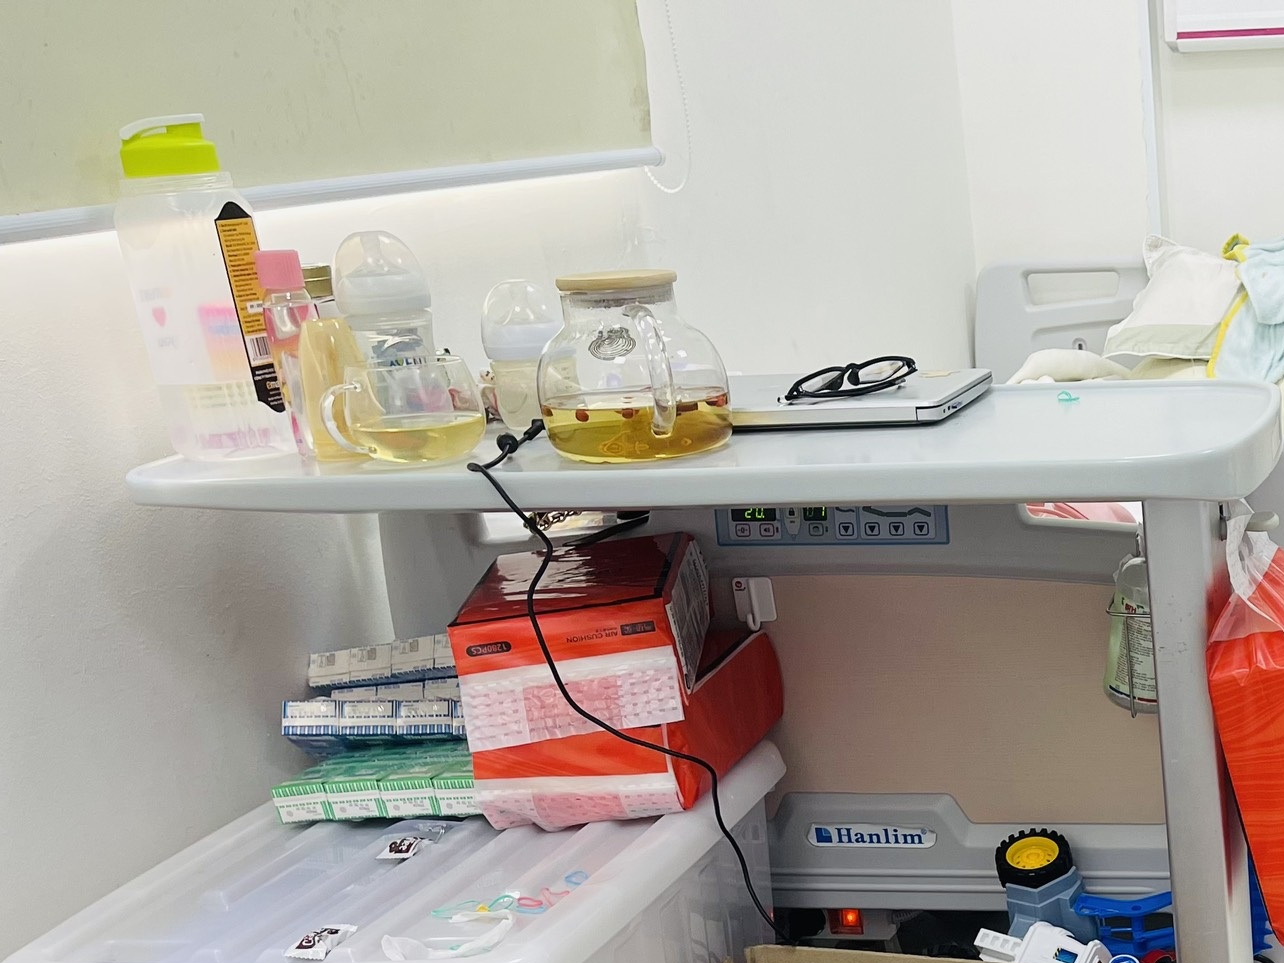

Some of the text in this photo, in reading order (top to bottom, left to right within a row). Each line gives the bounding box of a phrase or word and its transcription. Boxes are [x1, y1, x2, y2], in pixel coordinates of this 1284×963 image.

[566, 630, 618, 643] AIR CUSHION
[470, 643, 508, 656] 1280PCS
[834, 827, 925, 844] Hanlim
